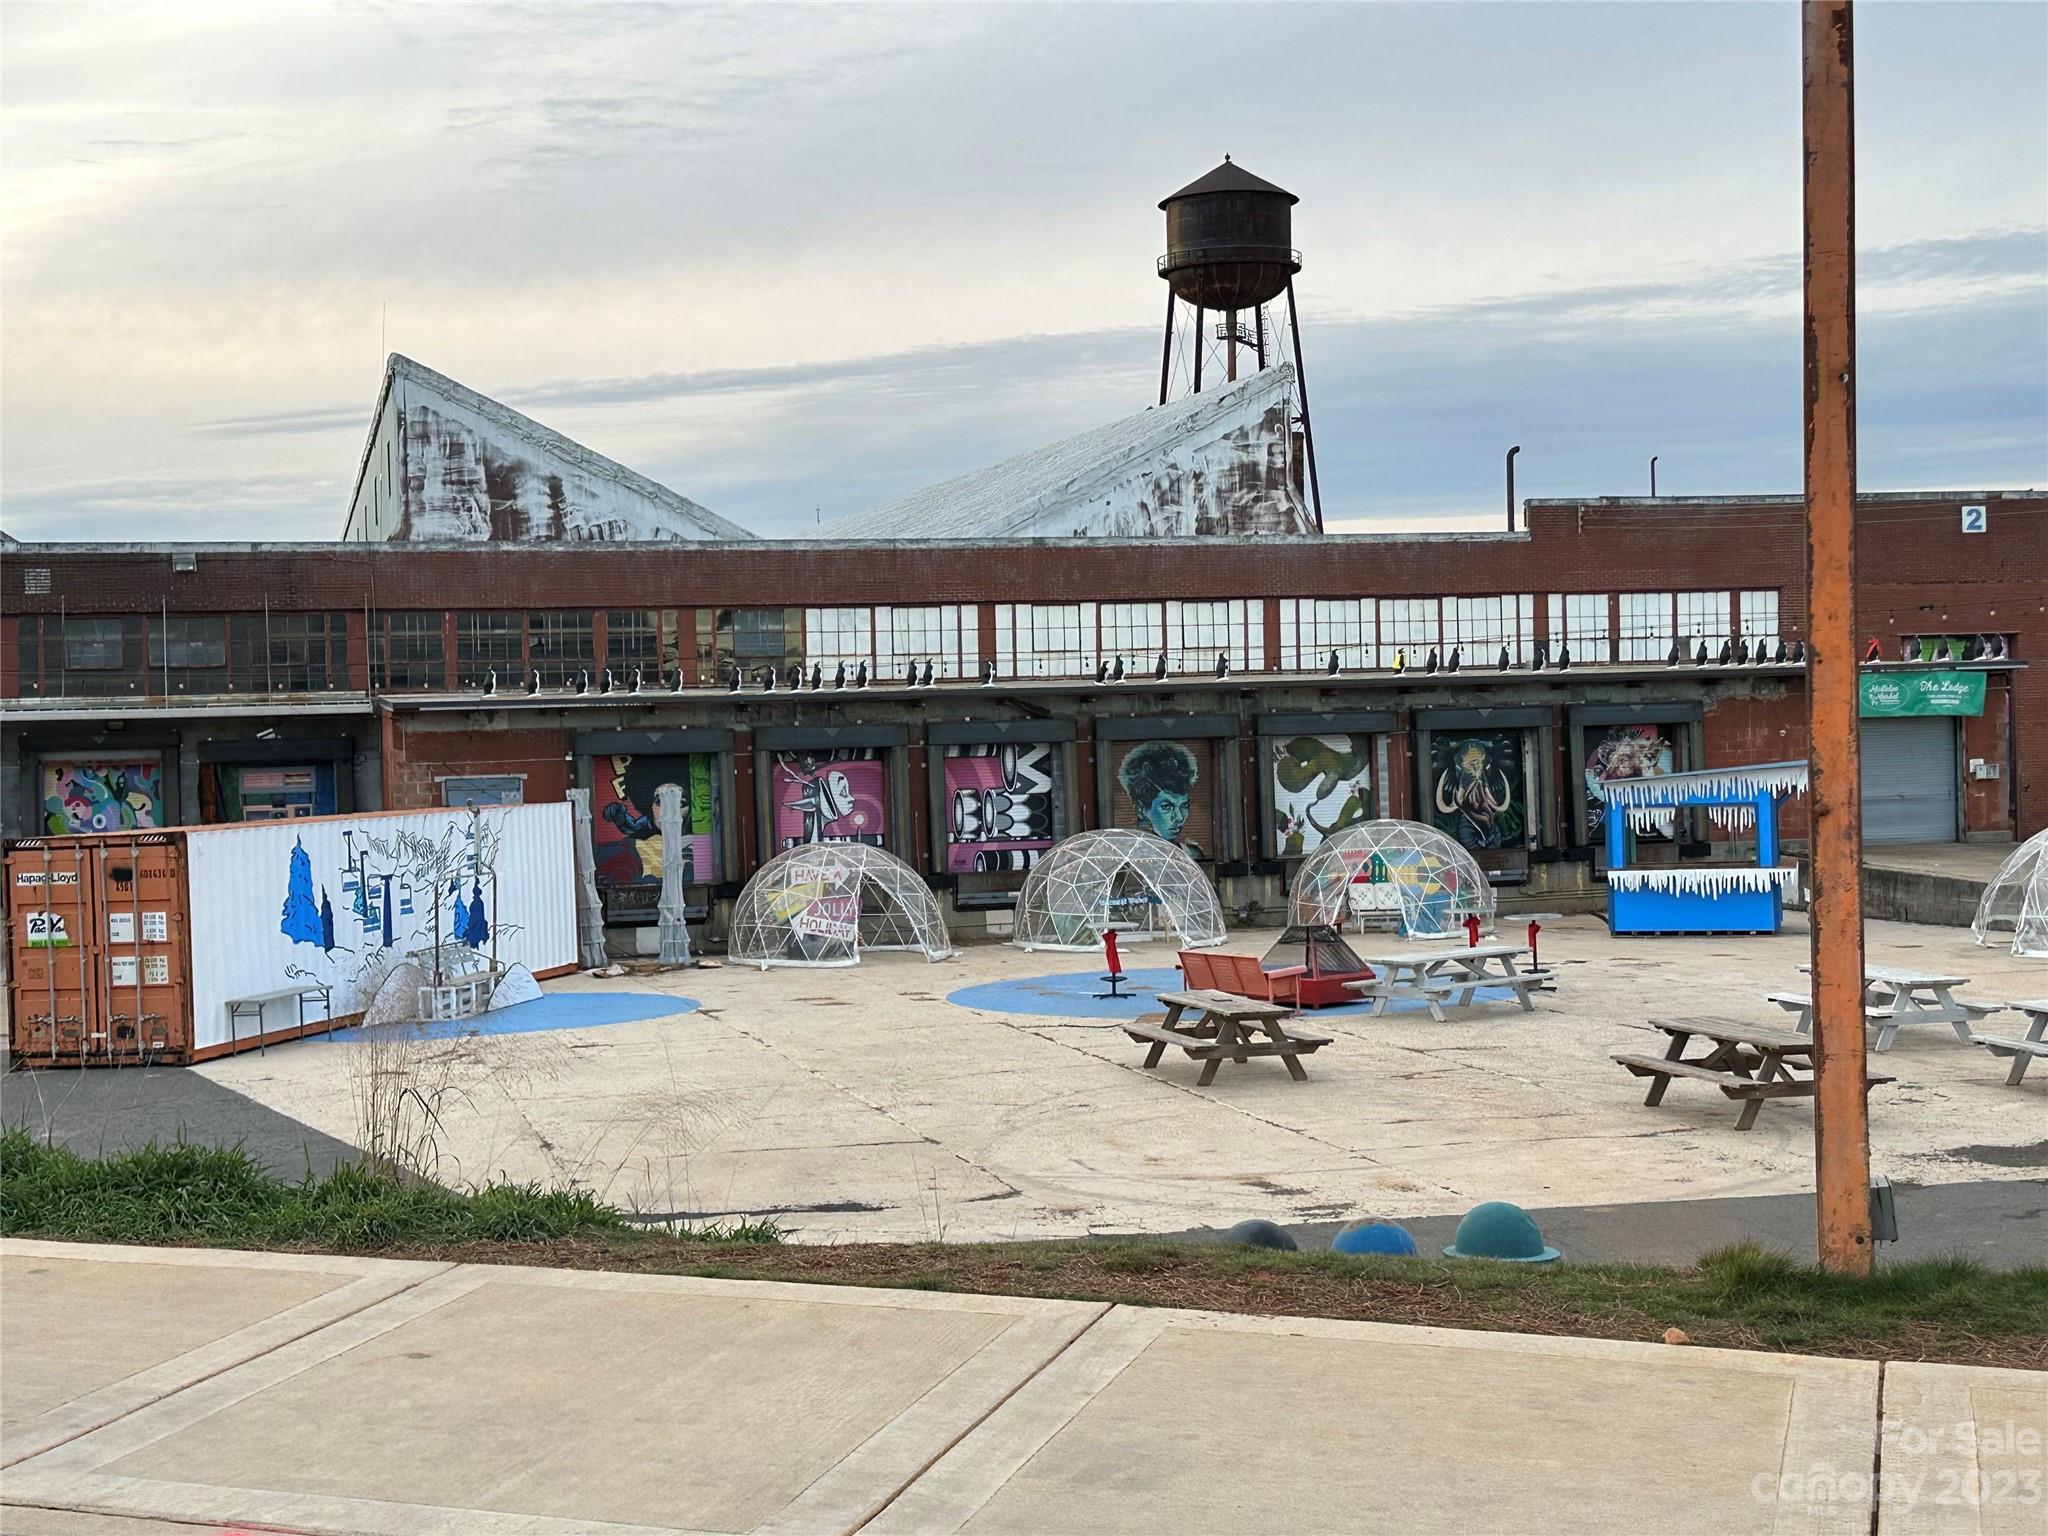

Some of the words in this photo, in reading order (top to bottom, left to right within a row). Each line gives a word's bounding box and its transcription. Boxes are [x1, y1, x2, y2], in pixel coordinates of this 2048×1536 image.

[1966, 508, 1983, 531] 2
[1920, 681, 1939, 692] The
[1941, 680, 1970, 695] Lodge
[17, 873, 78, 885] Hapag-Lloyd
[814, 901, 855, 918] JOLLY
[800, 917, 850, 939] HOLIDAY
